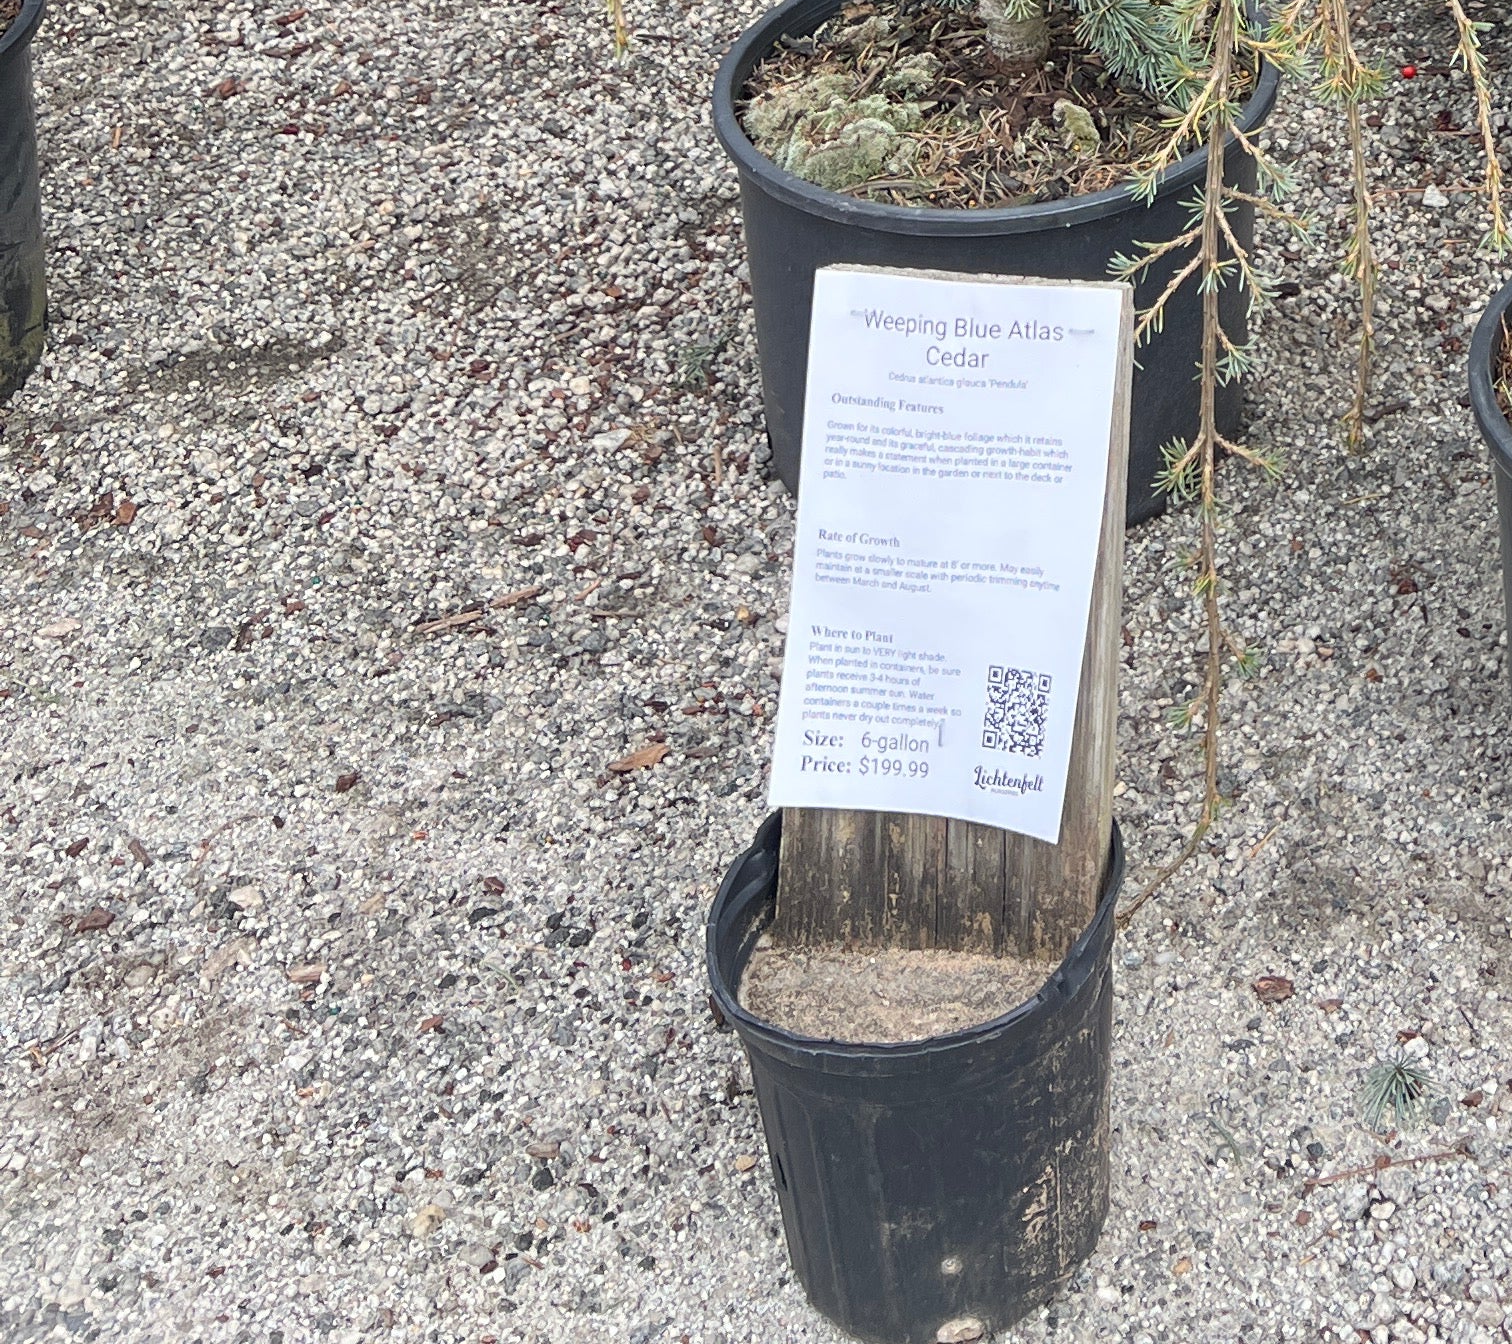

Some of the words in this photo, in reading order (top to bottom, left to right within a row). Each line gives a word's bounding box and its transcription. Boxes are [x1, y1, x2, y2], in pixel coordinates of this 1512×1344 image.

[864, 309, 947, 341] Weeping
[954, 318, 1001, 339] Blue
[1008, 320, 1064, 342] Atlas
[926, 345, 990, 369] Cedar
[832, 392, 896, 412] Outstanding
[899, 399, 944, 415] Features
[857, 422, 868, 431] for
[872, 438, 887, 447] and
[819, 529, 843, 542] Rate
[846, 533, 858, 543] of
[860, 533, 900, 547] Growth
[817, 548, 843, 559] Plants
[812, 625, 848, 639] Where
[852, 630, 862, 640] to
[865, 630, 893, 643] Plant
[809, 642, 832, 652] Plant
[873, 647, 896, 657] VERY
[808, 655, 833, 665] When
[885, 674, 909, 685] hours
[911, 677, 920, 686] of
[909, 689, 935, 701] Water
[833, 712, 857, 721] never
[859, 713, 873, 725] dry
[875, 715, 889, 723] out
[803, 730, 844, 748] Size:
[862, 731, 929, 754] 6-gallon
[801, 755, 851, 774] Price:
[859, 757, 929, 778] $199.99
[974, 765, 1044, 794] Lichtenfelt
